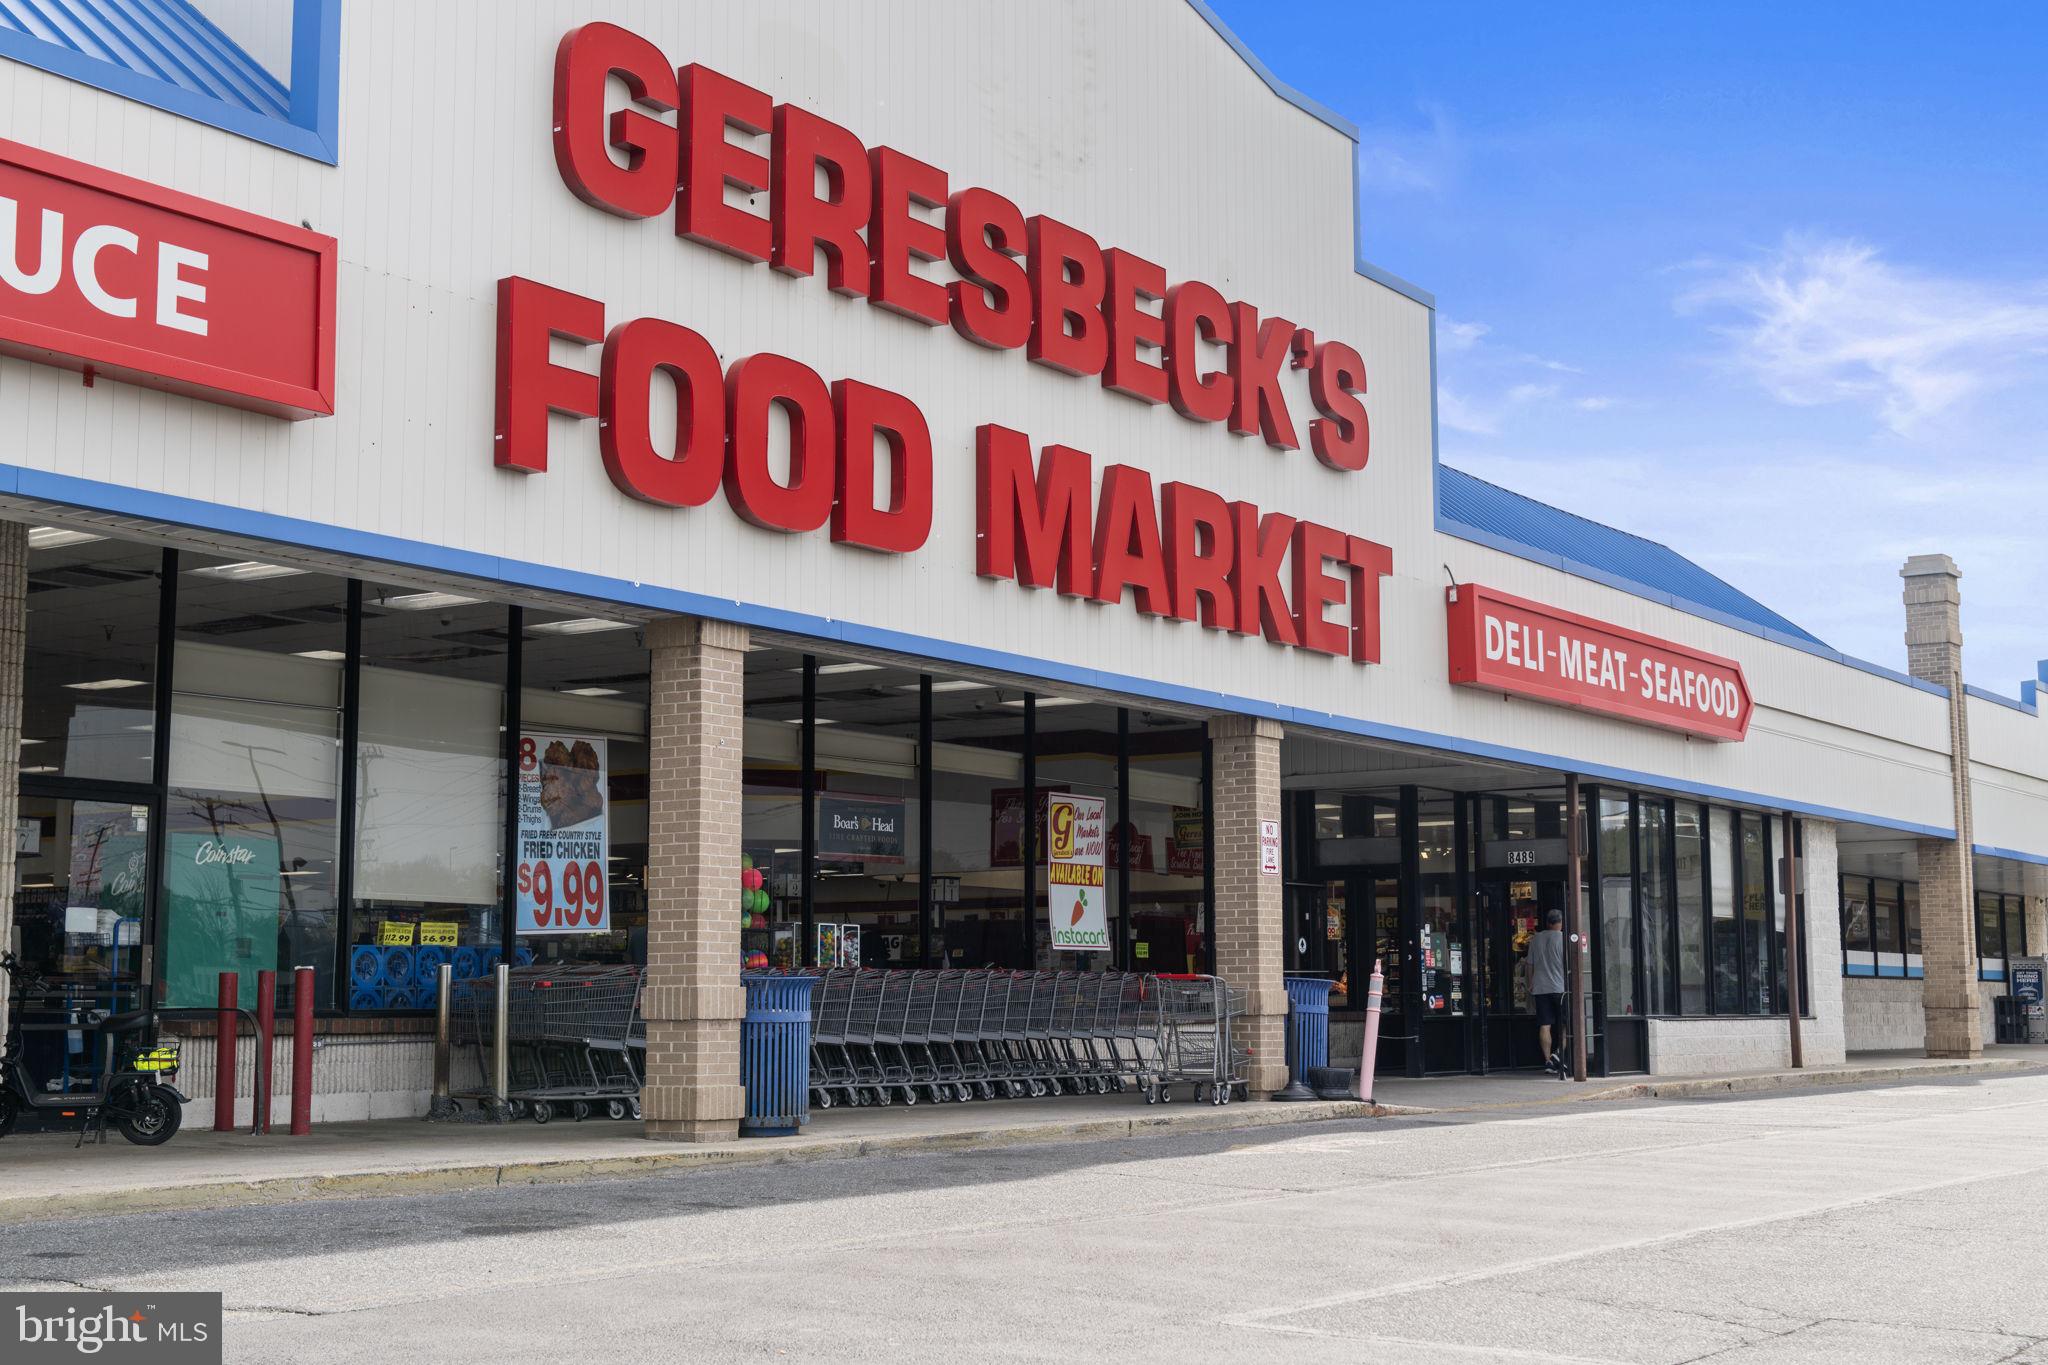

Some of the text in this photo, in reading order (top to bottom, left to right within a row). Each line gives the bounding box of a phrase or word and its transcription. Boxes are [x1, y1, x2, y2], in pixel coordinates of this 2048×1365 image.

[553, 21, 1369, 472] GERESBECK'S
[0, 196, 209, 337] UCE
[495, 275, 1394, 664] FOOD MARKET
[519, 737, 537, 772] 8
[518, 773, 540, 783] IECES
[1086, 806, 1103, 821] Local
[833, 815, 894, 832] Boar's Head
[1076, 824, 1100, 839] Markets
[1265, 825, 1273, 835] NO
[520, 830, 602, 841] FRIED FRESH COUNTRY STYLE
[195, 840, 257, 865] Coinstar
[523, 841, 601, 860] FRIED CHICKEN
[1509, 851, 1534, 863] 8489
[1050, 863, 1104, 886] AVAILABLE ON
[518, 860, 604, 928] $9.99
[422, 934, 455, 943] $6.99
[1053, 926, 1106, 945] instacart
